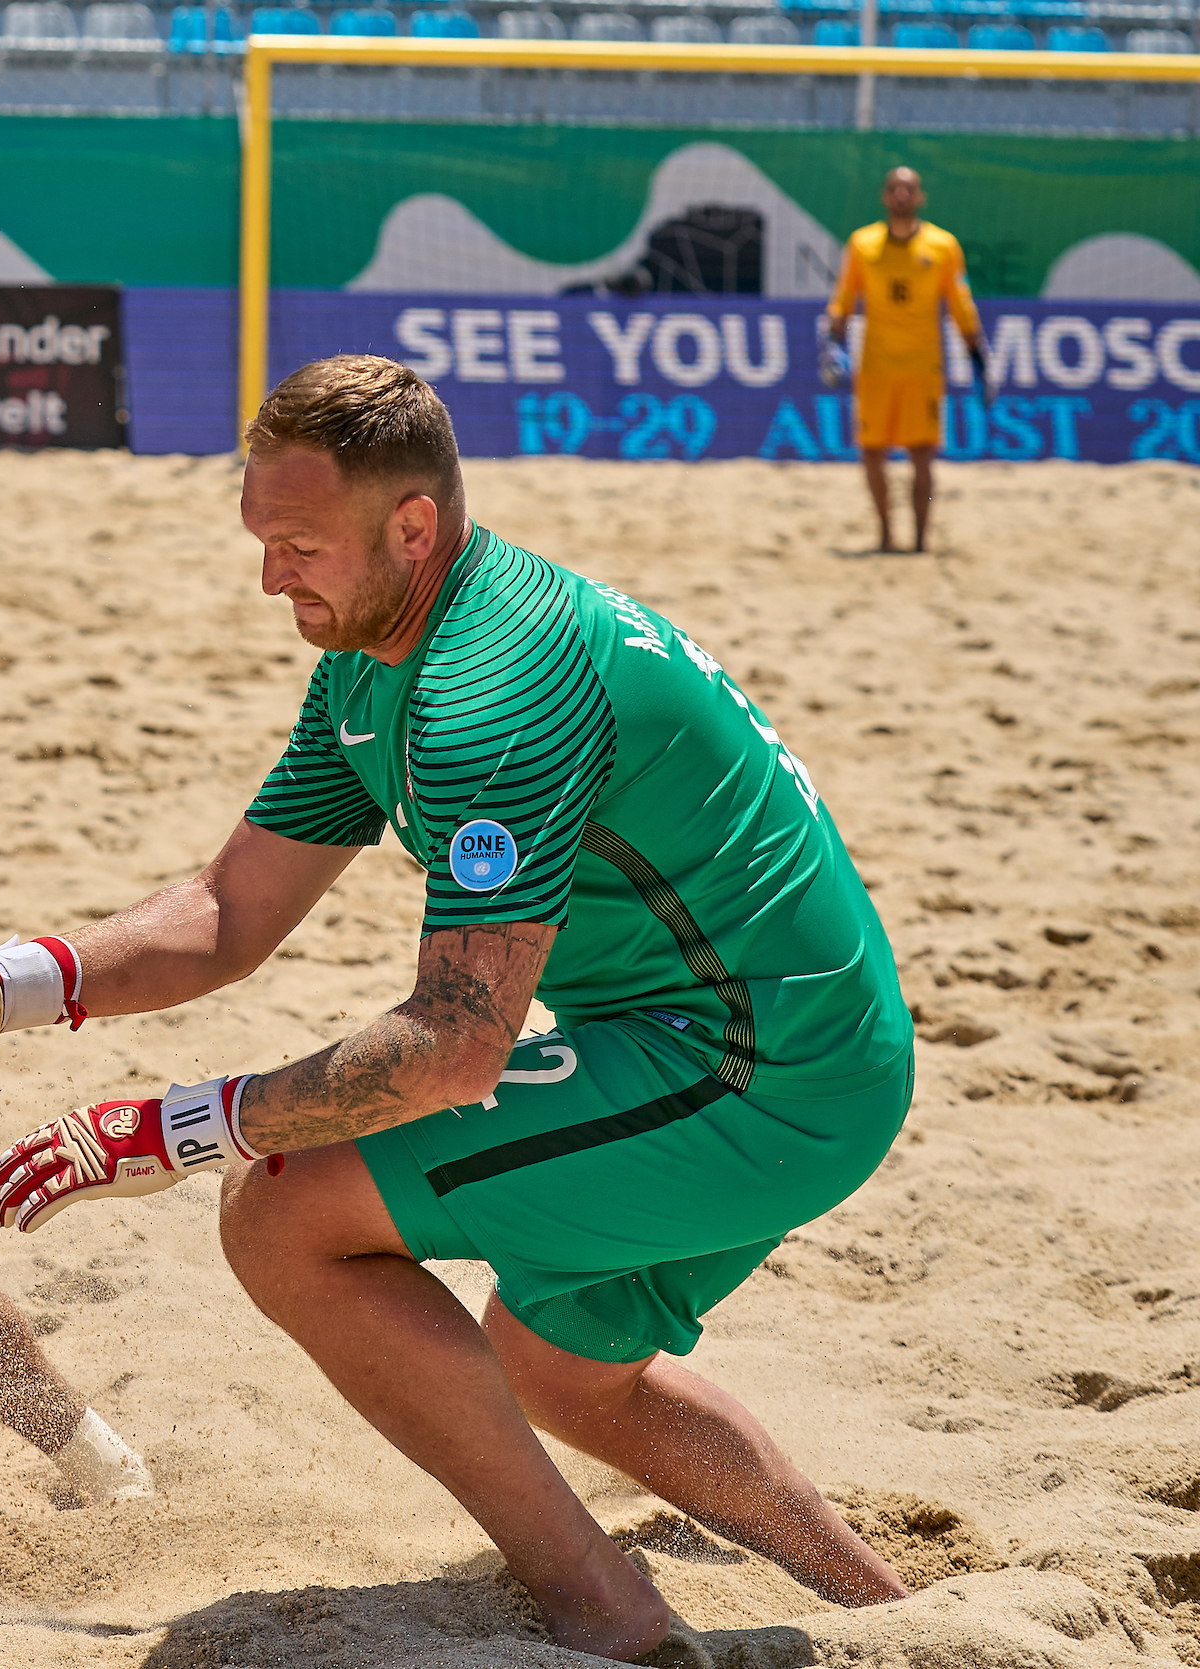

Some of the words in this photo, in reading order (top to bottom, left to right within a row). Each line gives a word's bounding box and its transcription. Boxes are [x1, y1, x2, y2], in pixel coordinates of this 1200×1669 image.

[395, 307, 567, 384] SEE
[586, 310, 790, 388] YOU
[514, 391, 717, 460] 19-29
[759, 394, 1092, 461] AUUST
[460, 834, 506, 853] ONE
[460, 851, 506, 861] HUMANITY
[176, 1137, 226, 1169] JP
